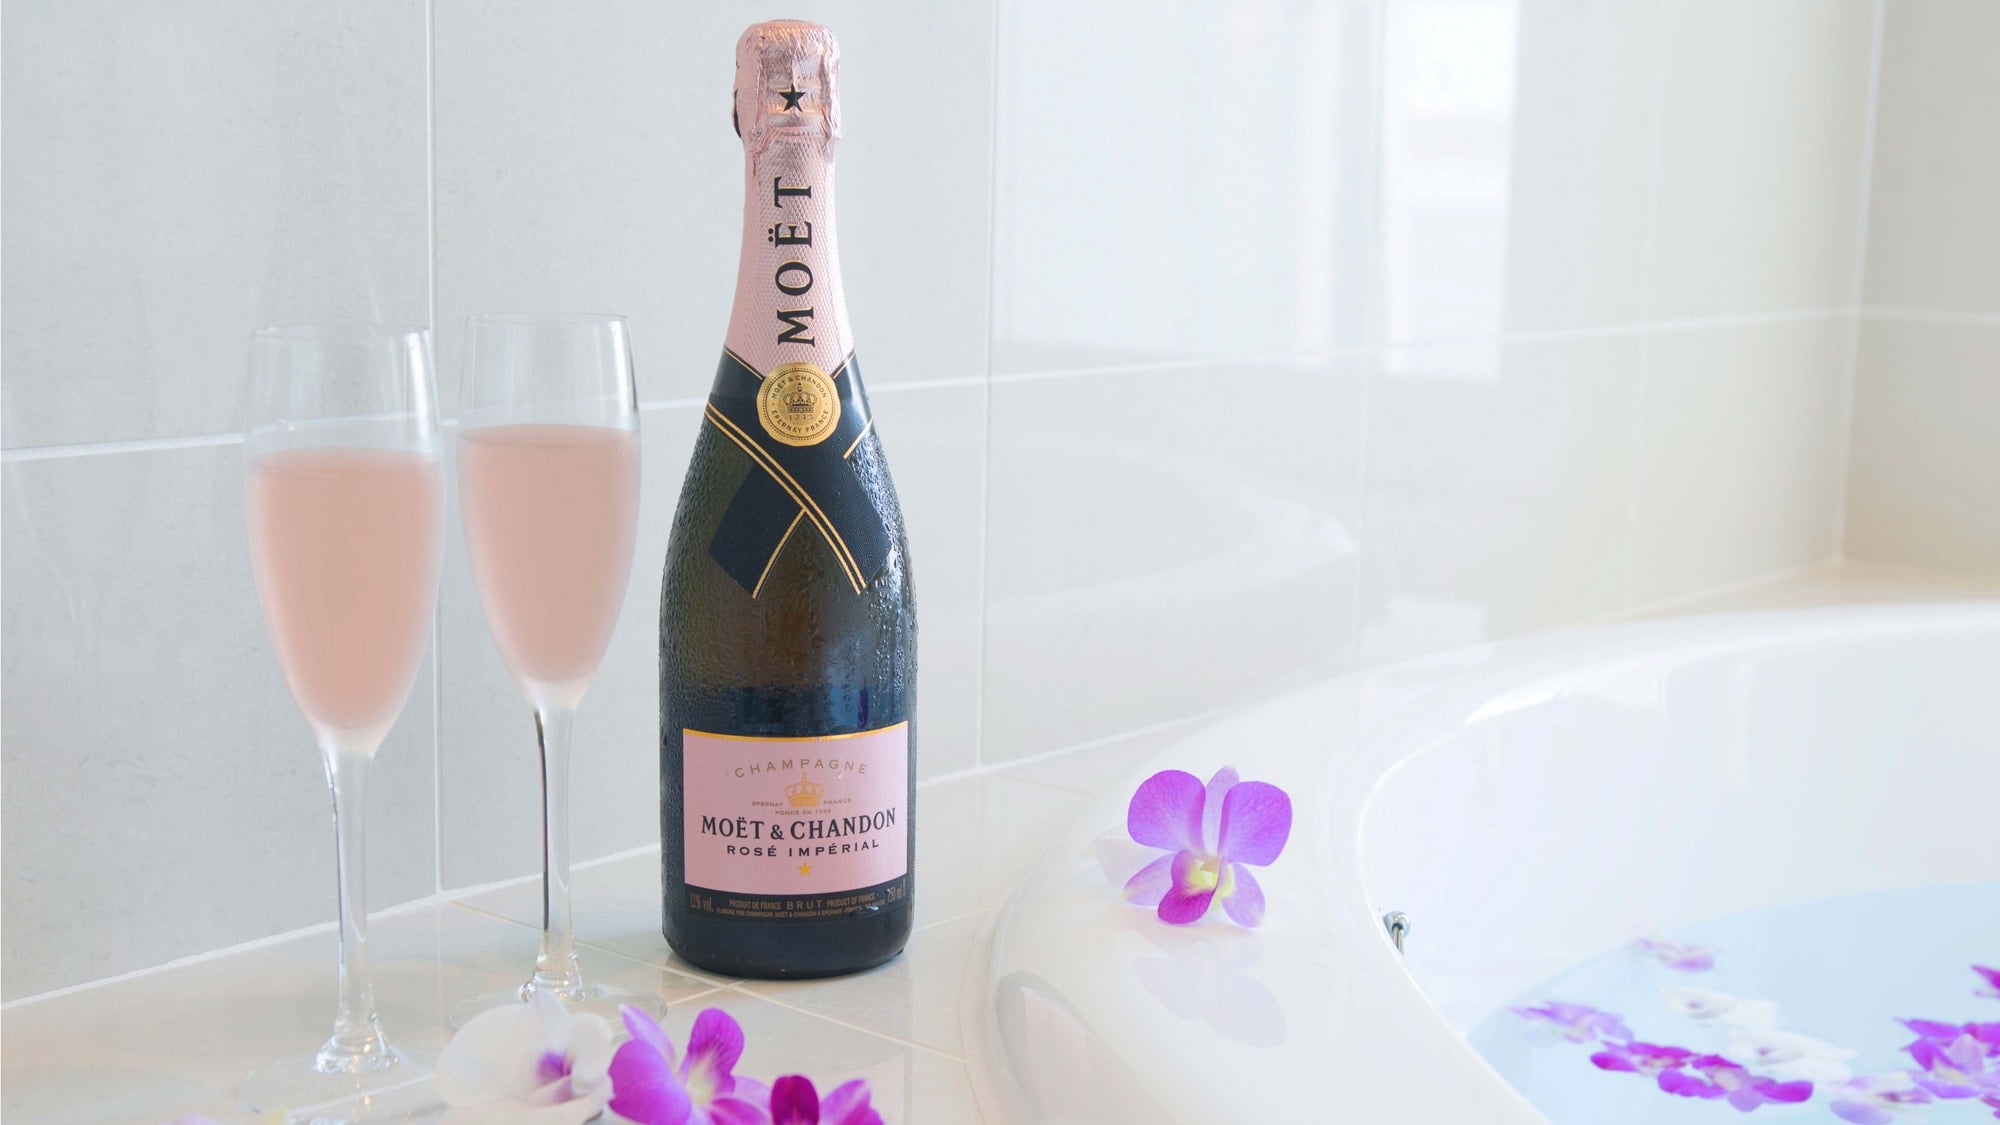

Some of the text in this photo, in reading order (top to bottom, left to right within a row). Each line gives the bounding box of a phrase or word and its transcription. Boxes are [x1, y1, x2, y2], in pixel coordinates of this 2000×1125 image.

[768, 176, 815, 347] MOËT
[795, 374, 828, 398] CHANDON
[805, 410, 829, 432] FRANCE
[734, 758, 867, 778] CHAMPAGNE
[701, 807, 896, 840] MOËT & CHANDON
[726, 839, 880, 857] ROSÉ IMPÉRIAL
[760, 902, 781, 910] FRANCE
[786, 900, 822, 910] BRUT
[826, 898, 850, 908] PRODUCT
[851, 896, 858, 905] OF
[858, 892, 874, 904] FRANCE
